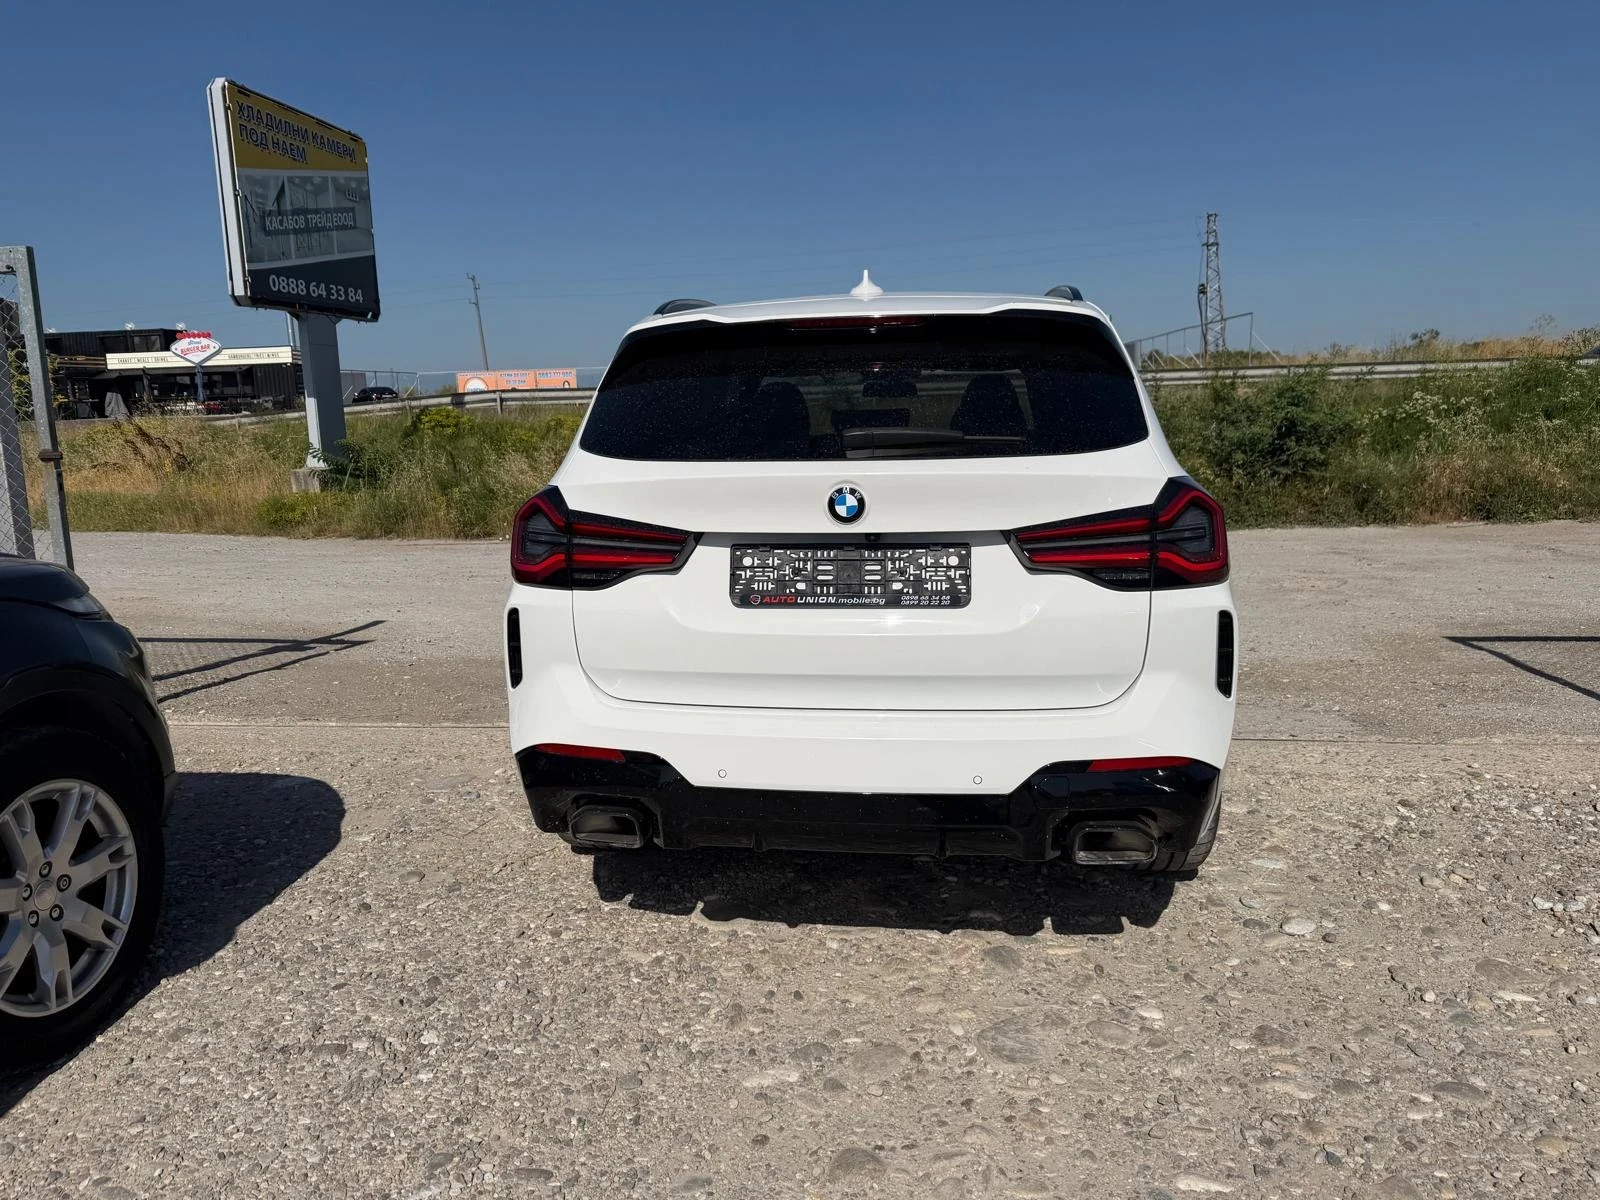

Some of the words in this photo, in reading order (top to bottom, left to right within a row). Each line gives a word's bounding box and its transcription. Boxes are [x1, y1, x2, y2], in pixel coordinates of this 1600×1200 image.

[236, 100, 310, 142] ХЛАДИЛНИ
[239, 123, 269, 148] ПОД
[272, 136, 307, 161] НАЕМ
[265, 214, 305, 231] КАСАБОВ
[307, 211, 332, 228] ТРЕЙД
[269, 274, 307, 296] 0888
[309, 281, 327, 298] 64
[329, 284, 345, 301] 33
[348, 287, 364, 304] 84
[180, 346, 200, 354] BURGER
[763, 595, 796, 603] AUTO
